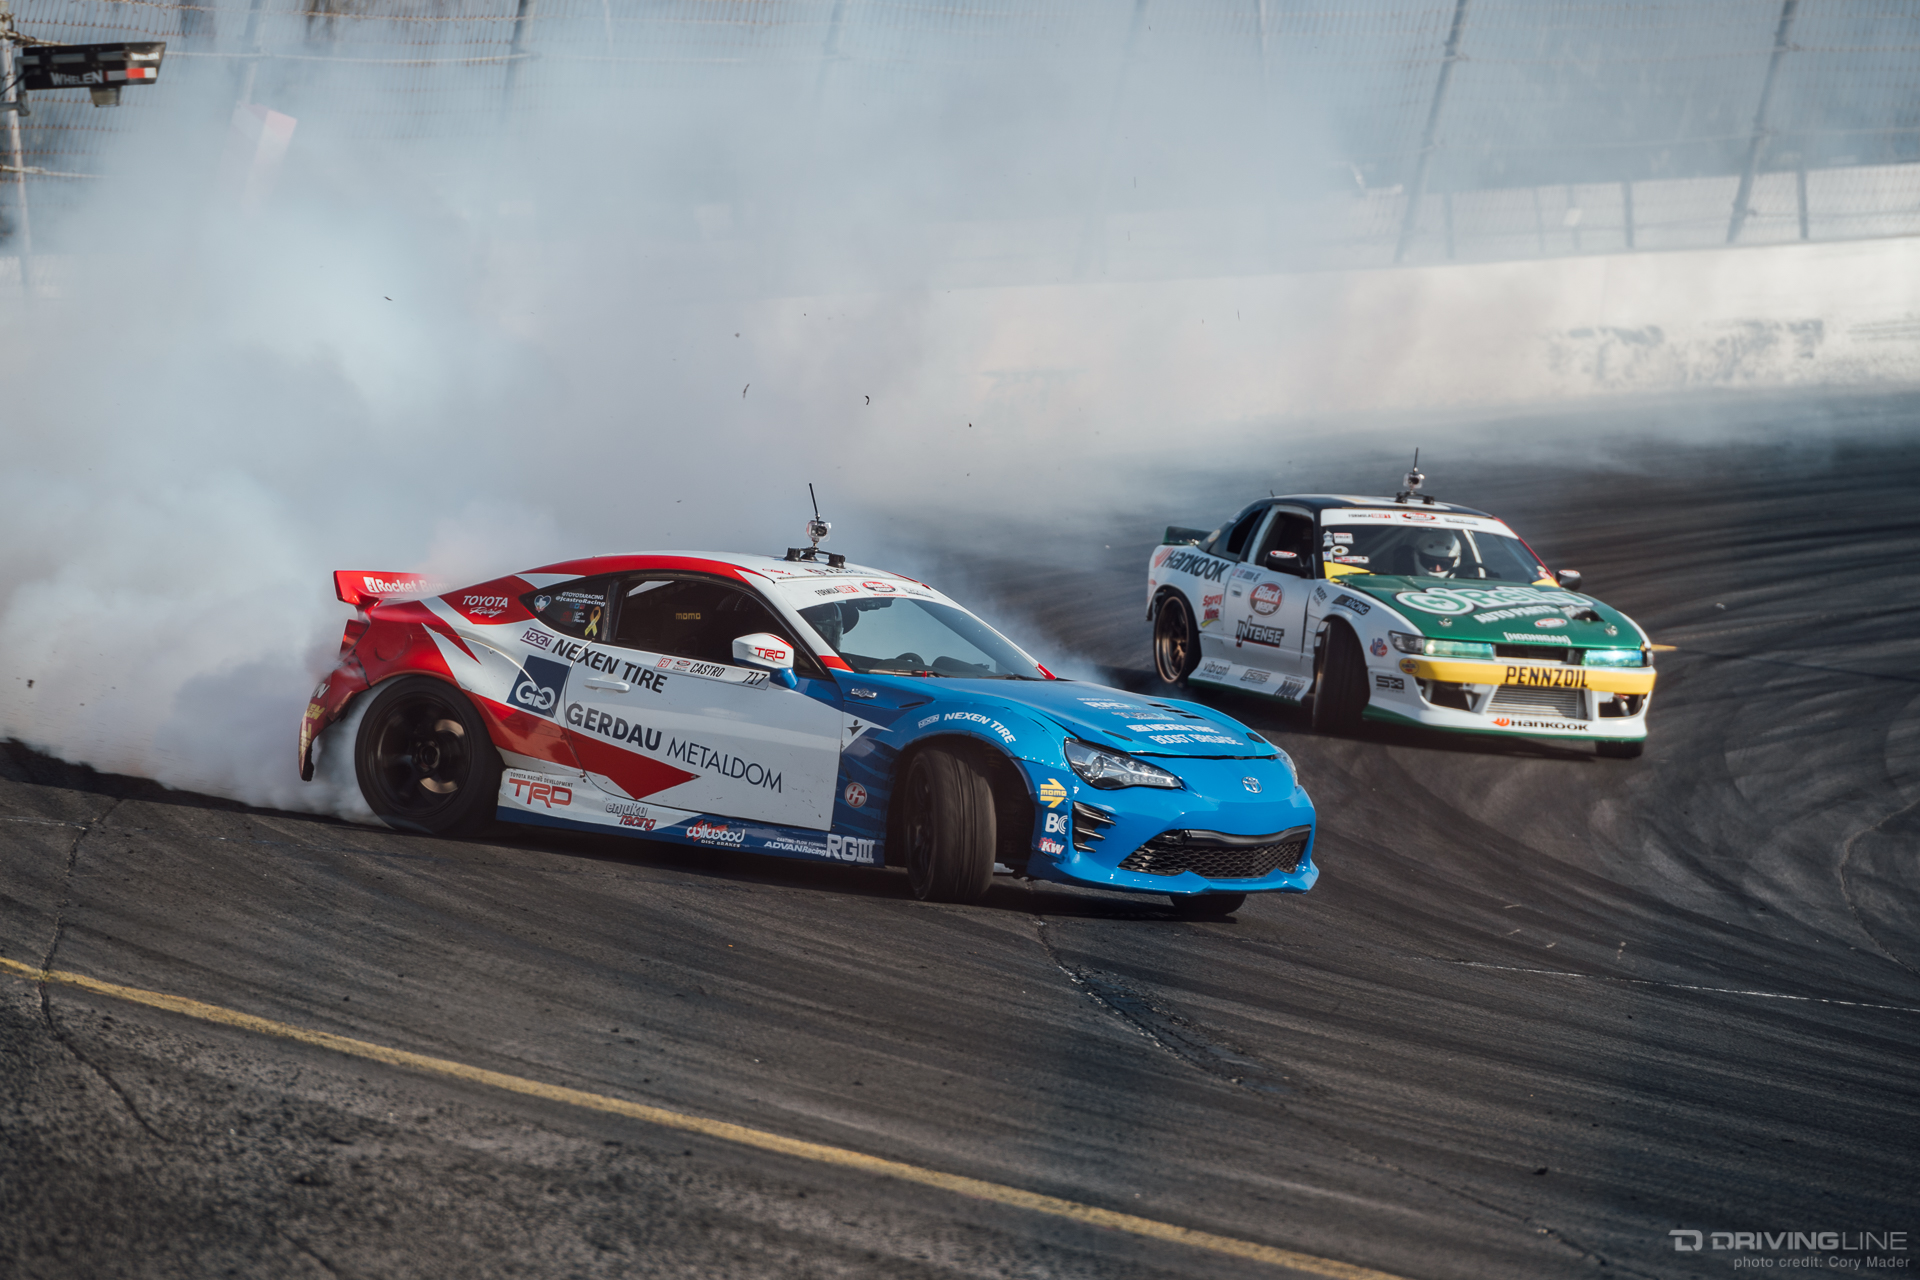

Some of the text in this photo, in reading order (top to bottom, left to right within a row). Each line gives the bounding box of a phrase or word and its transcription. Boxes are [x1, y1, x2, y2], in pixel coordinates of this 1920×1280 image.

[50, 69, 104, 86] WHELEN
[374, 578, 419, 593] Rocket
[1254, 583, 1283, 602] Black
[462, 595, 509, 608] TOYOTA
[1202, 593, 1224, 606] Spray
[675, 612, 701, 620] momo
[1203, 607, 1220, 620] Nine
[1236, 615, 1285, 647] INTENSE
[754, 647, 786, 661] TRD
[551, 639, 668, 694] NEXEN TIRE
[690, 663, 726, 678] CASTRO
[742, 671, 768, 686] 717
[1504, 666, 1589, 688] PENNZOIL
[944, 712, 1017, 744] NEXEN TIRE
[566, 703, 782, 794] GERDAU METALDOM
[510, 772, 574, 788] TOYOTA RACING DEVELOPMENT
[508, 778, 573, 809] TRD
[1040, 789, 1067, 797] momo
[685, 822, 746, 843] wilwood
[763, 841, 827, 857] ADVAN Racing
[1040, 841, 1065, 855] KW
